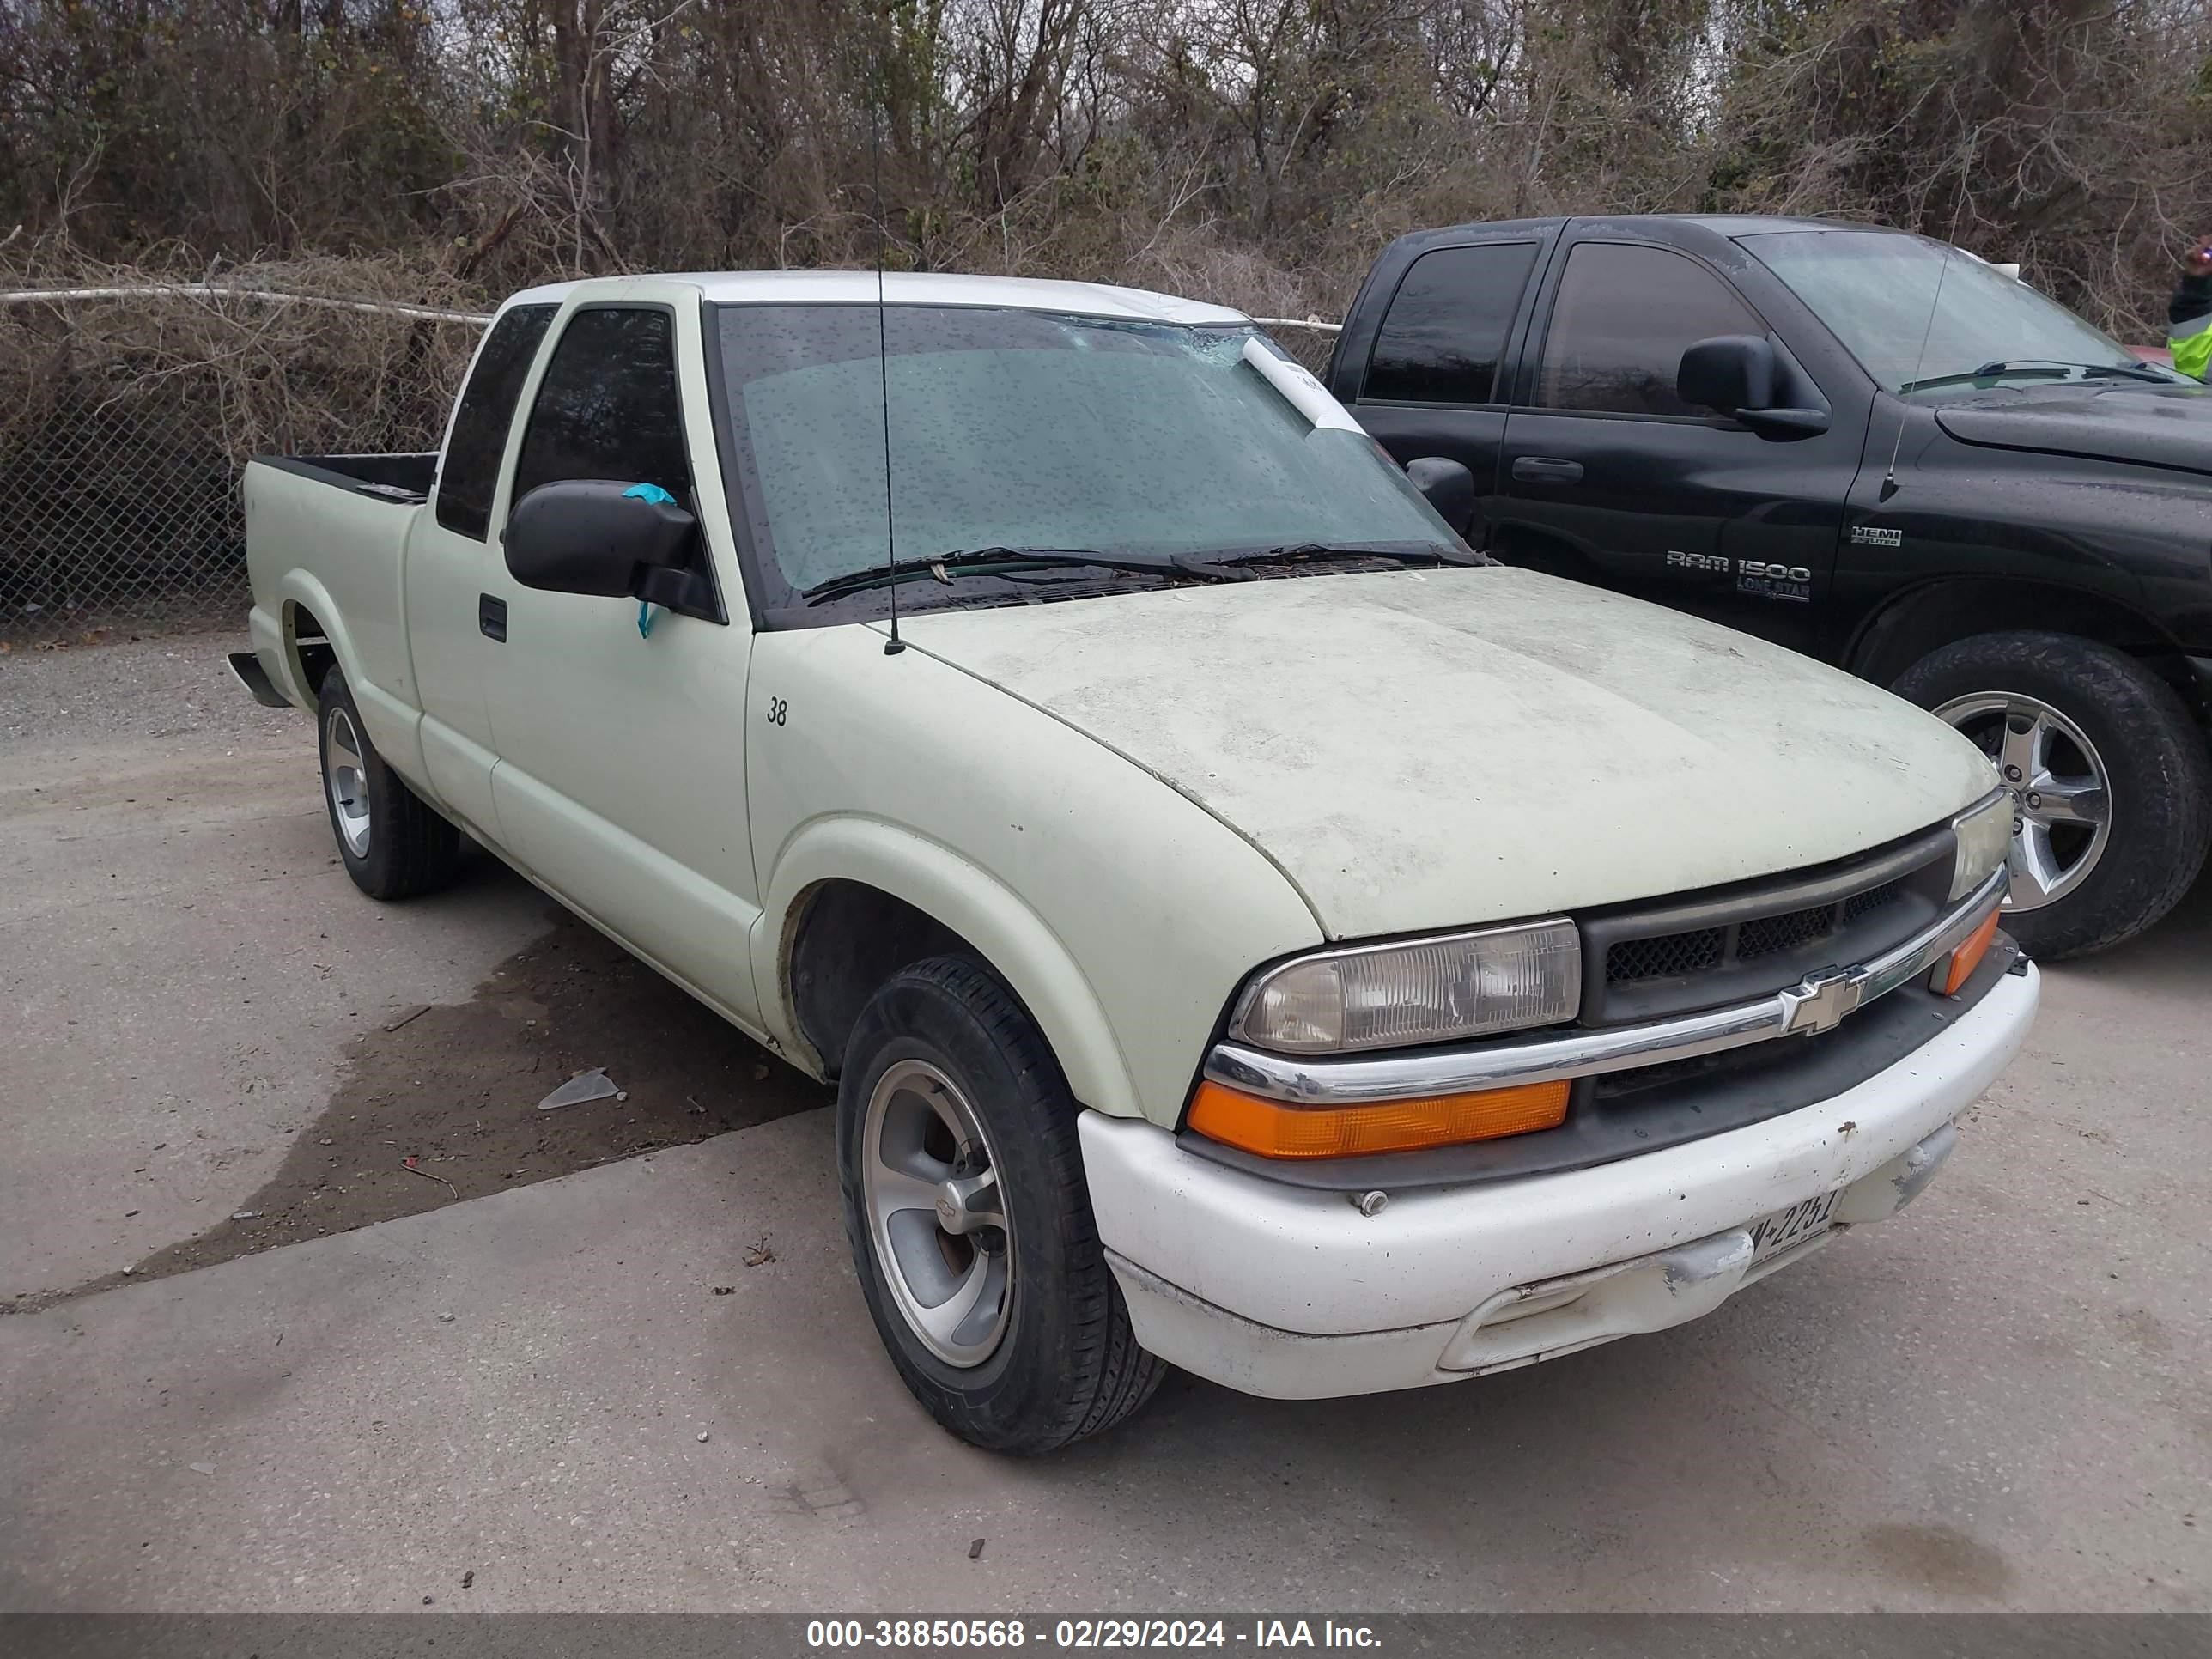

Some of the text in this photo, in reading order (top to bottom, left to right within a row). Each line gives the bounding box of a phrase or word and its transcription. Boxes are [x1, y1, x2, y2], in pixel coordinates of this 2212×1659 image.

[1852, 526, 1901, 539] HEMI
[1667, 550, 1811, 582] RAM 1500
[1737, 576, 1810, 597] LONE STAR
[767, 696, 787, 726] 38
